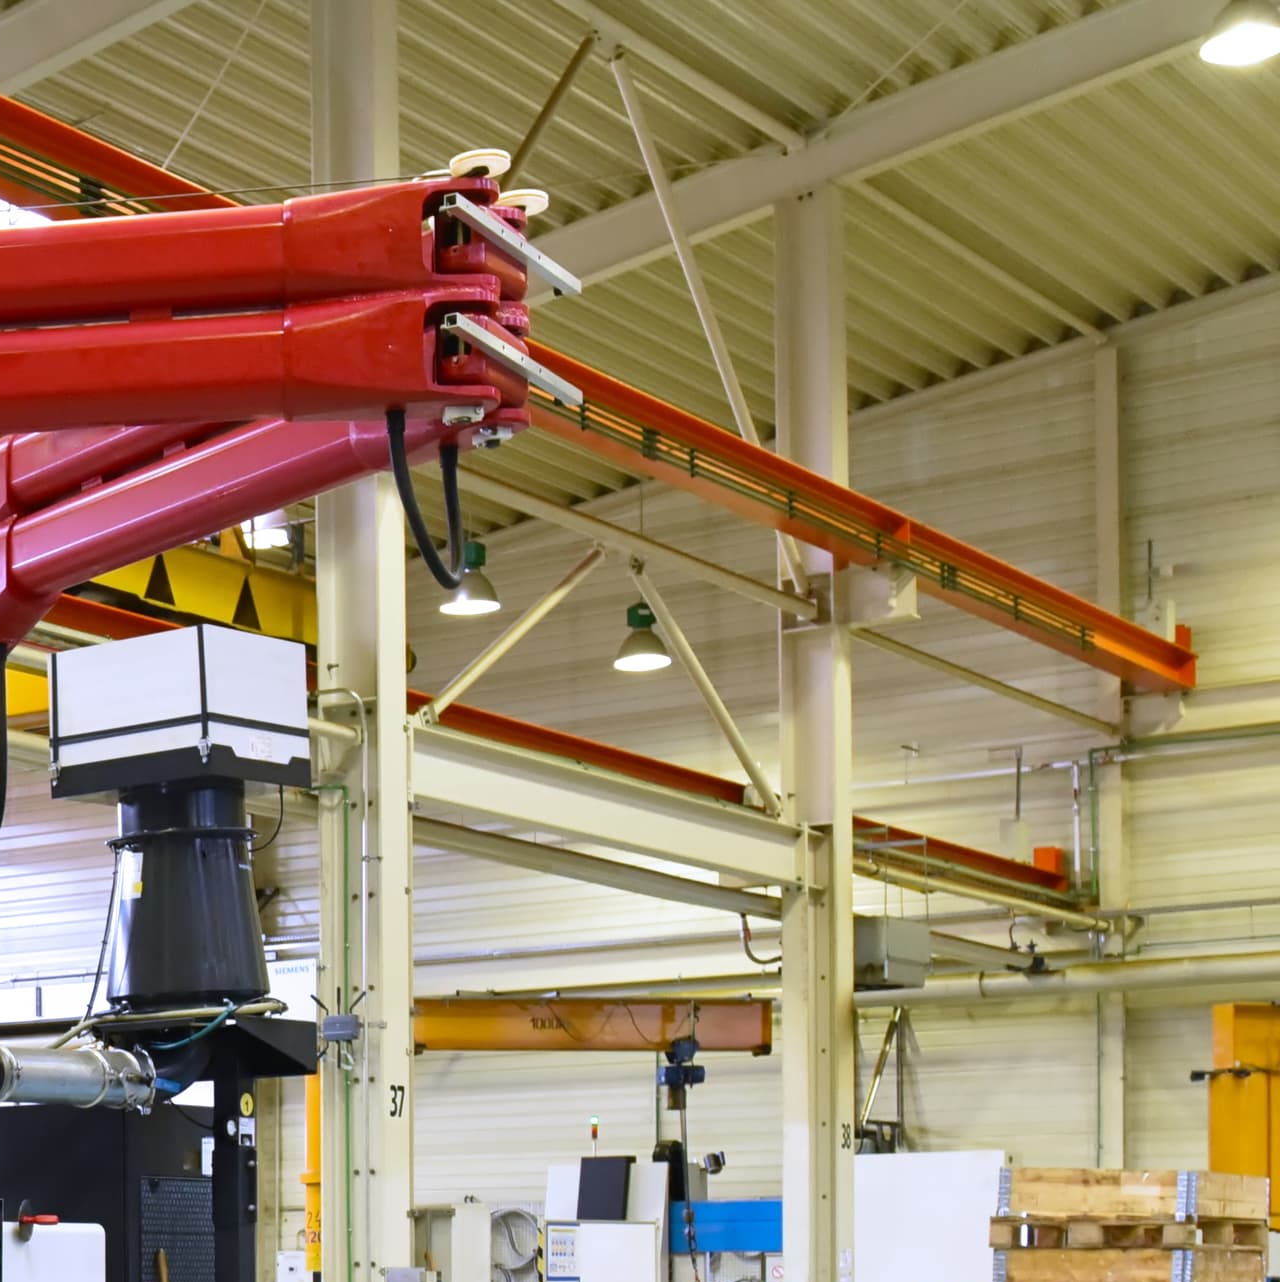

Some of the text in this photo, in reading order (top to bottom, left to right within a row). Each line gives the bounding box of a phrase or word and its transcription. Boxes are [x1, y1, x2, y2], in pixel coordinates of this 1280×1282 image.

[274, 965, 310, 975] SIEMENS
[390, 1084, 405, 1118] 37
[841, 1123, 851, 1150] 38
